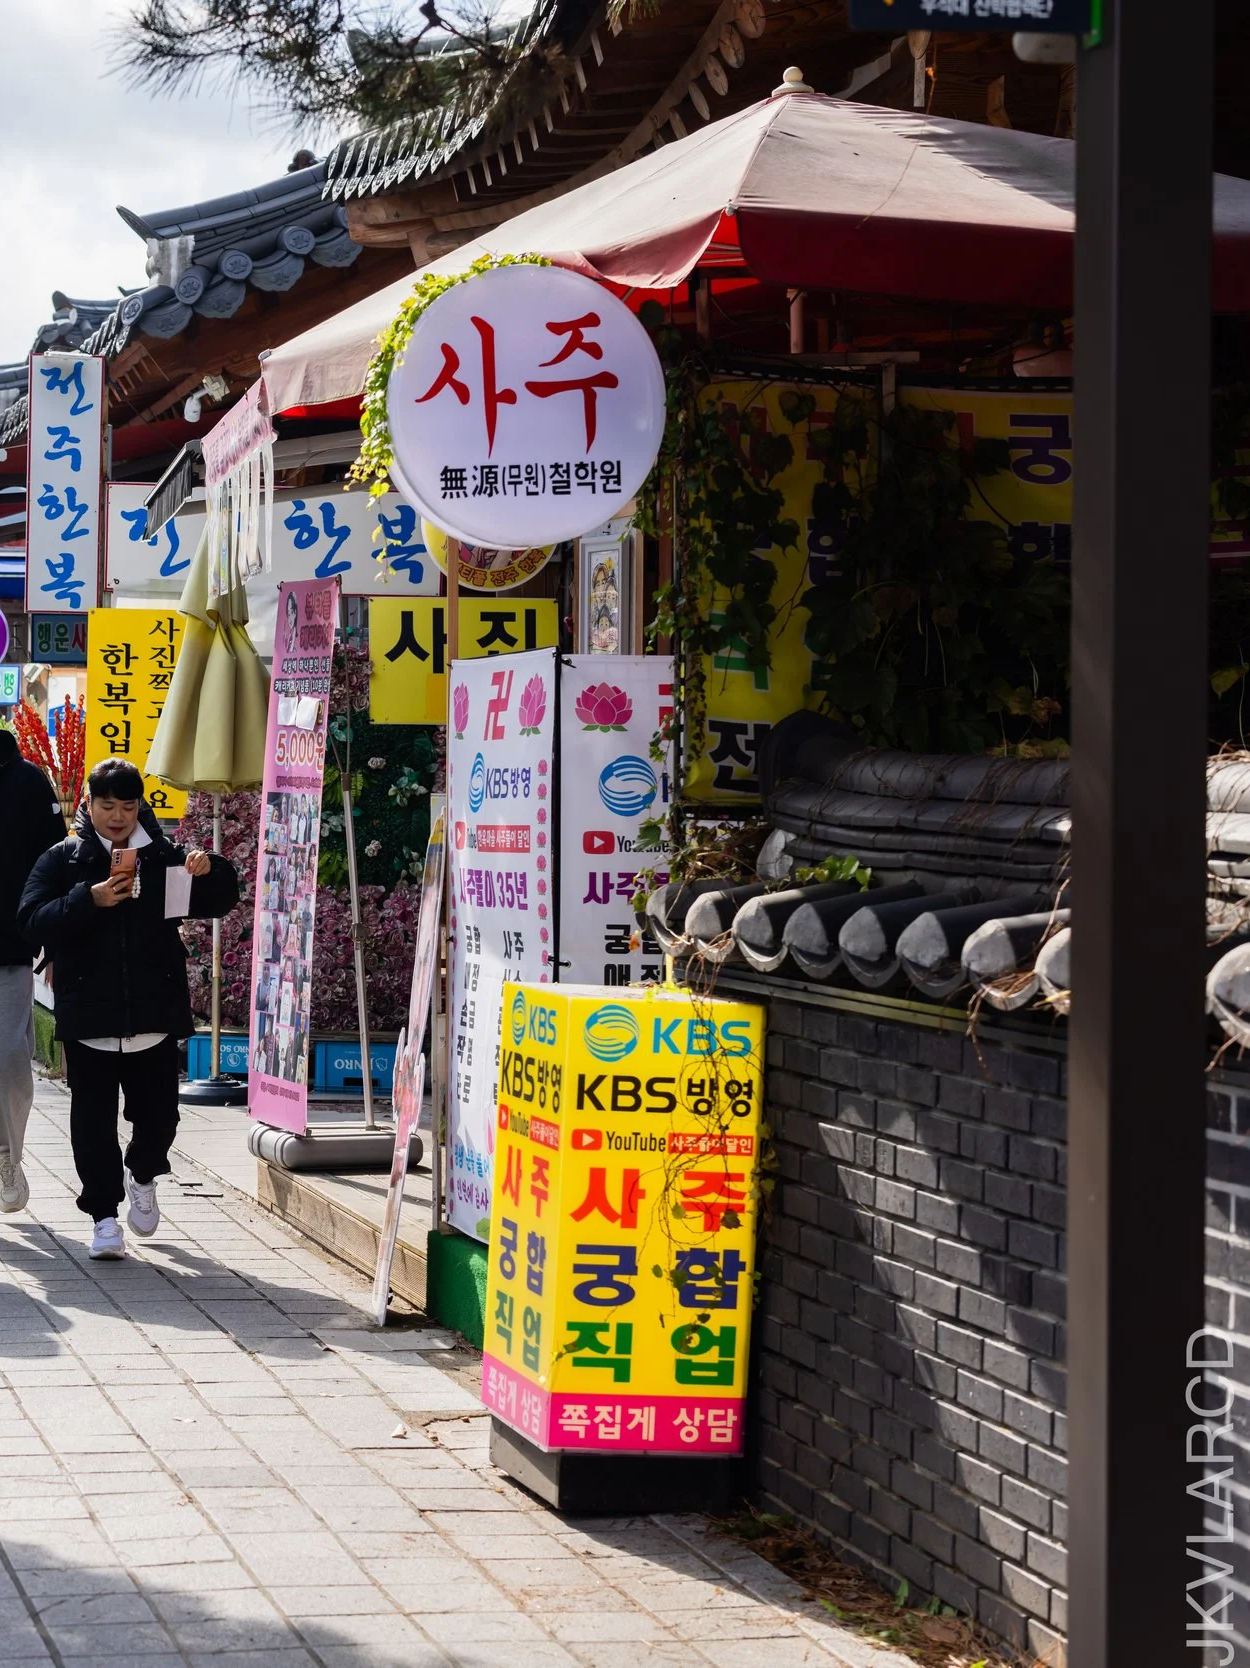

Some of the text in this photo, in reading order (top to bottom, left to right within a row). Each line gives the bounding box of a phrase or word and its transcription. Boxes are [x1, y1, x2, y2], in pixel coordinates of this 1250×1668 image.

[414, 311, 619, 460] 사주
[37, 361, 94, 610] 전주한복
[120, 500, 428, 584] 전한복
[458, 547, 547, 587] 티풀 전주 한복
[385, 607, 537, 675] 사진
[485, 767, 509, 799] KBS
[503, 930, 525, 961] 사주
[529, 1003, 557, 1046] KBS
[652, 1017, 753, 1058] KBS
[501, 1048, 535, 1103] KBS
[537, 1059, 563, 1114] 방영
[576, 1073, 754, 1118] KBS 방영
[606, 1131, 667, 1152] YouTube
[501, 1145, 550, 1218] 사주
[569, 1167, 747, 1233] 사주
[499, 1216, 547, 1297] 궁합
[572, 1243, 747, 1310] 궁합
[494, 1289, 542, 1373] 직업
[563, 1320, 737, 1386] 직업
[487, 1365, 543, 1436] 쪽집게 상담
[558, 1404, 738, 1443] 쪽집게 상담
